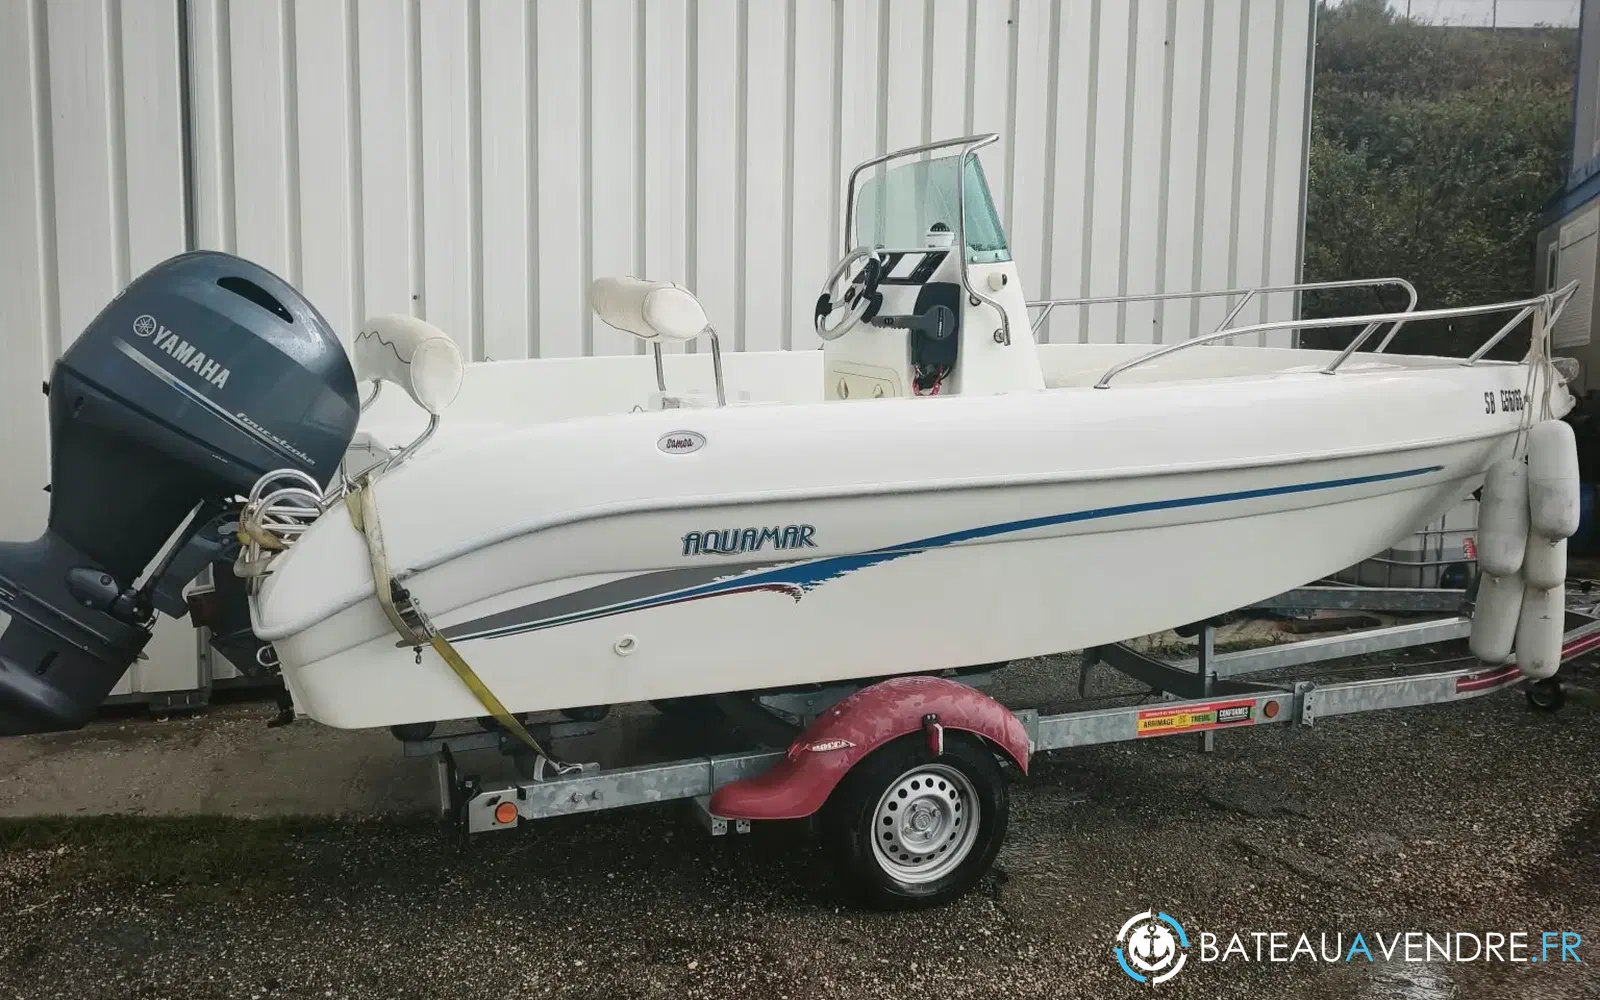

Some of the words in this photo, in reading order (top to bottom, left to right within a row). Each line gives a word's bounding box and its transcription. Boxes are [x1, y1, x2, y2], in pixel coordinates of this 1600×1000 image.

[152, 326, 230, 389] YAMAHA
[1484, 392, 1496, 414] SB
[681, 524, 818, 556] AQUAMAR
[1143, 719, 1174, 729] ARRIMAGE
[1219, 707, 1249, 717] CONFORMES
